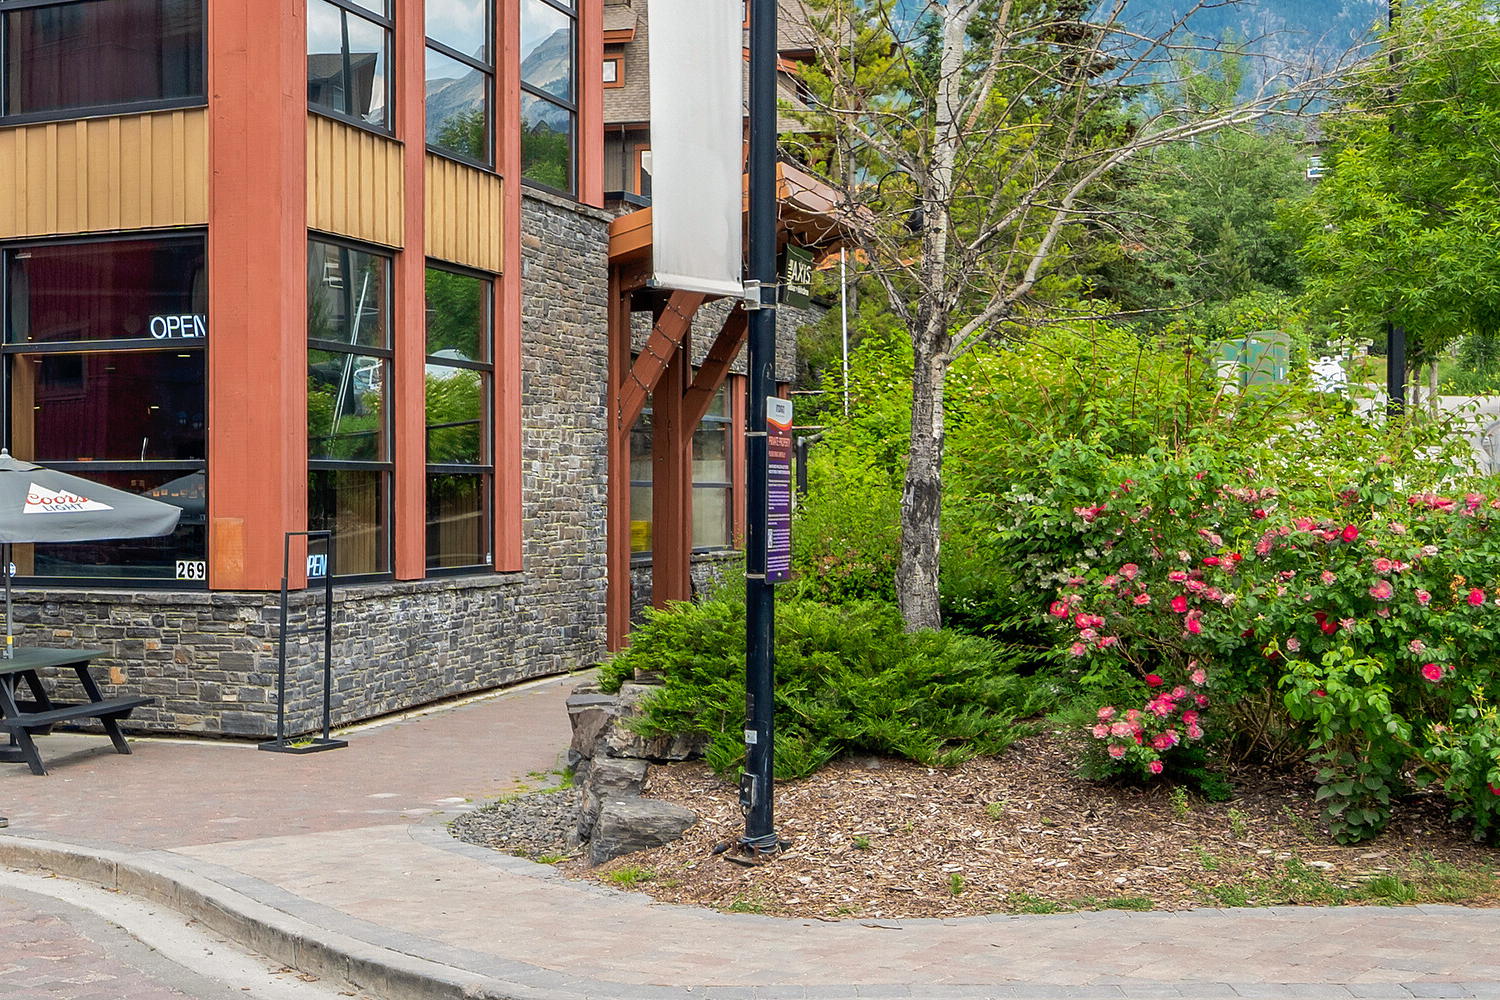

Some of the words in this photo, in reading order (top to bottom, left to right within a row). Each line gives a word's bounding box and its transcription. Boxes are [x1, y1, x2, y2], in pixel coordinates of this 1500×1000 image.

[791, 260, 812, 284] AXIS
[150, 314, 206, 339] OPEN
[26, 493, 90, 506] Coors
[42, 503, 84, 512] LIGHT
[178, 562, 204, 579] 269
[307, 554, 328, 577] PEN
